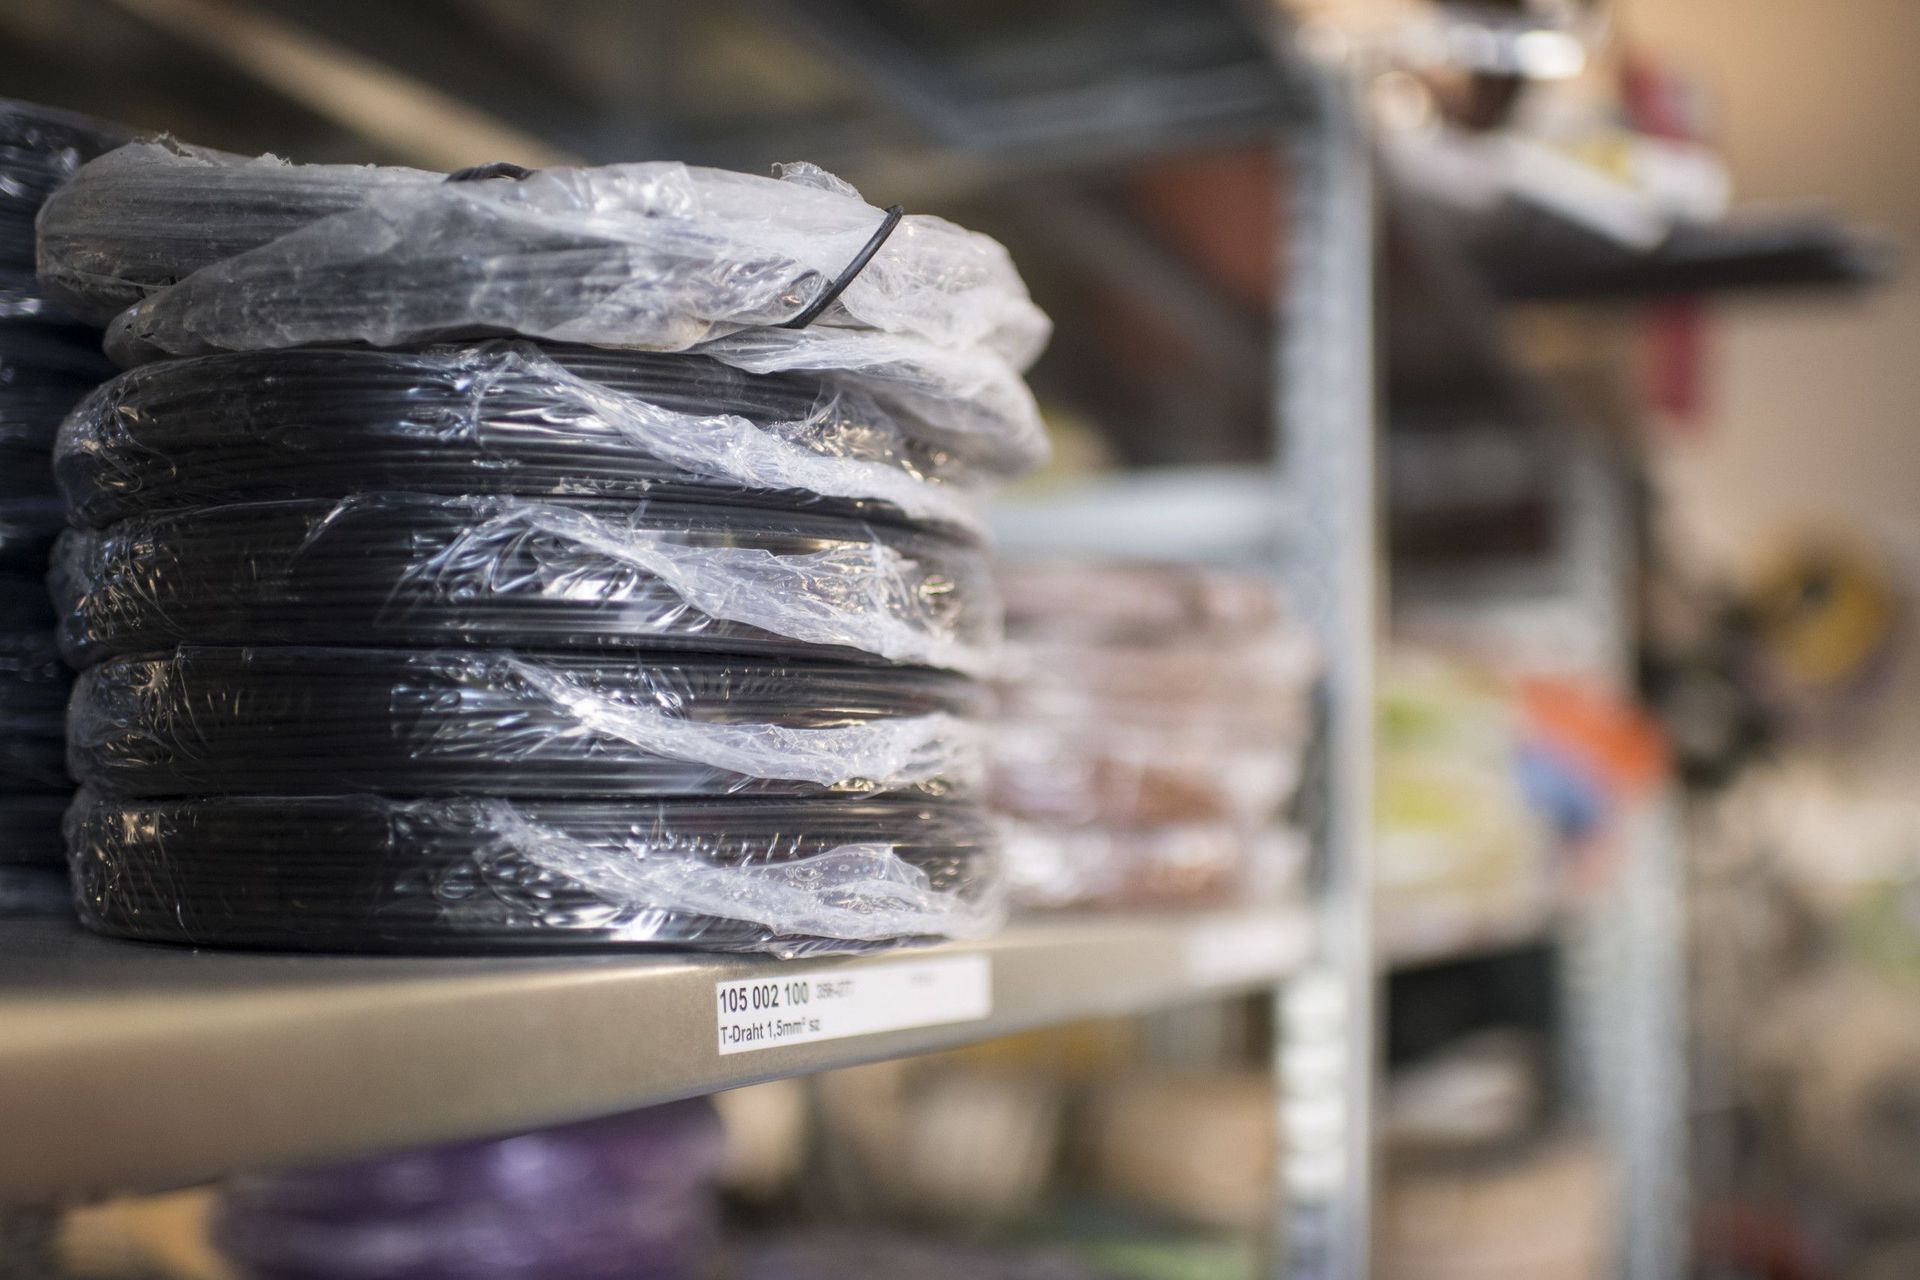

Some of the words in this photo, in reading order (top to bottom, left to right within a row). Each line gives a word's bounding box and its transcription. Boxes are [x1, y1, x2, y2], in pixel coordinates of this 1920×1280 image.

[720, 987, 748, 1013] 105
[752, 984, 779, 1010] 002
[784, 981, 809, 1006] 100
[720, 1023, 764, 1045] T-Draht
